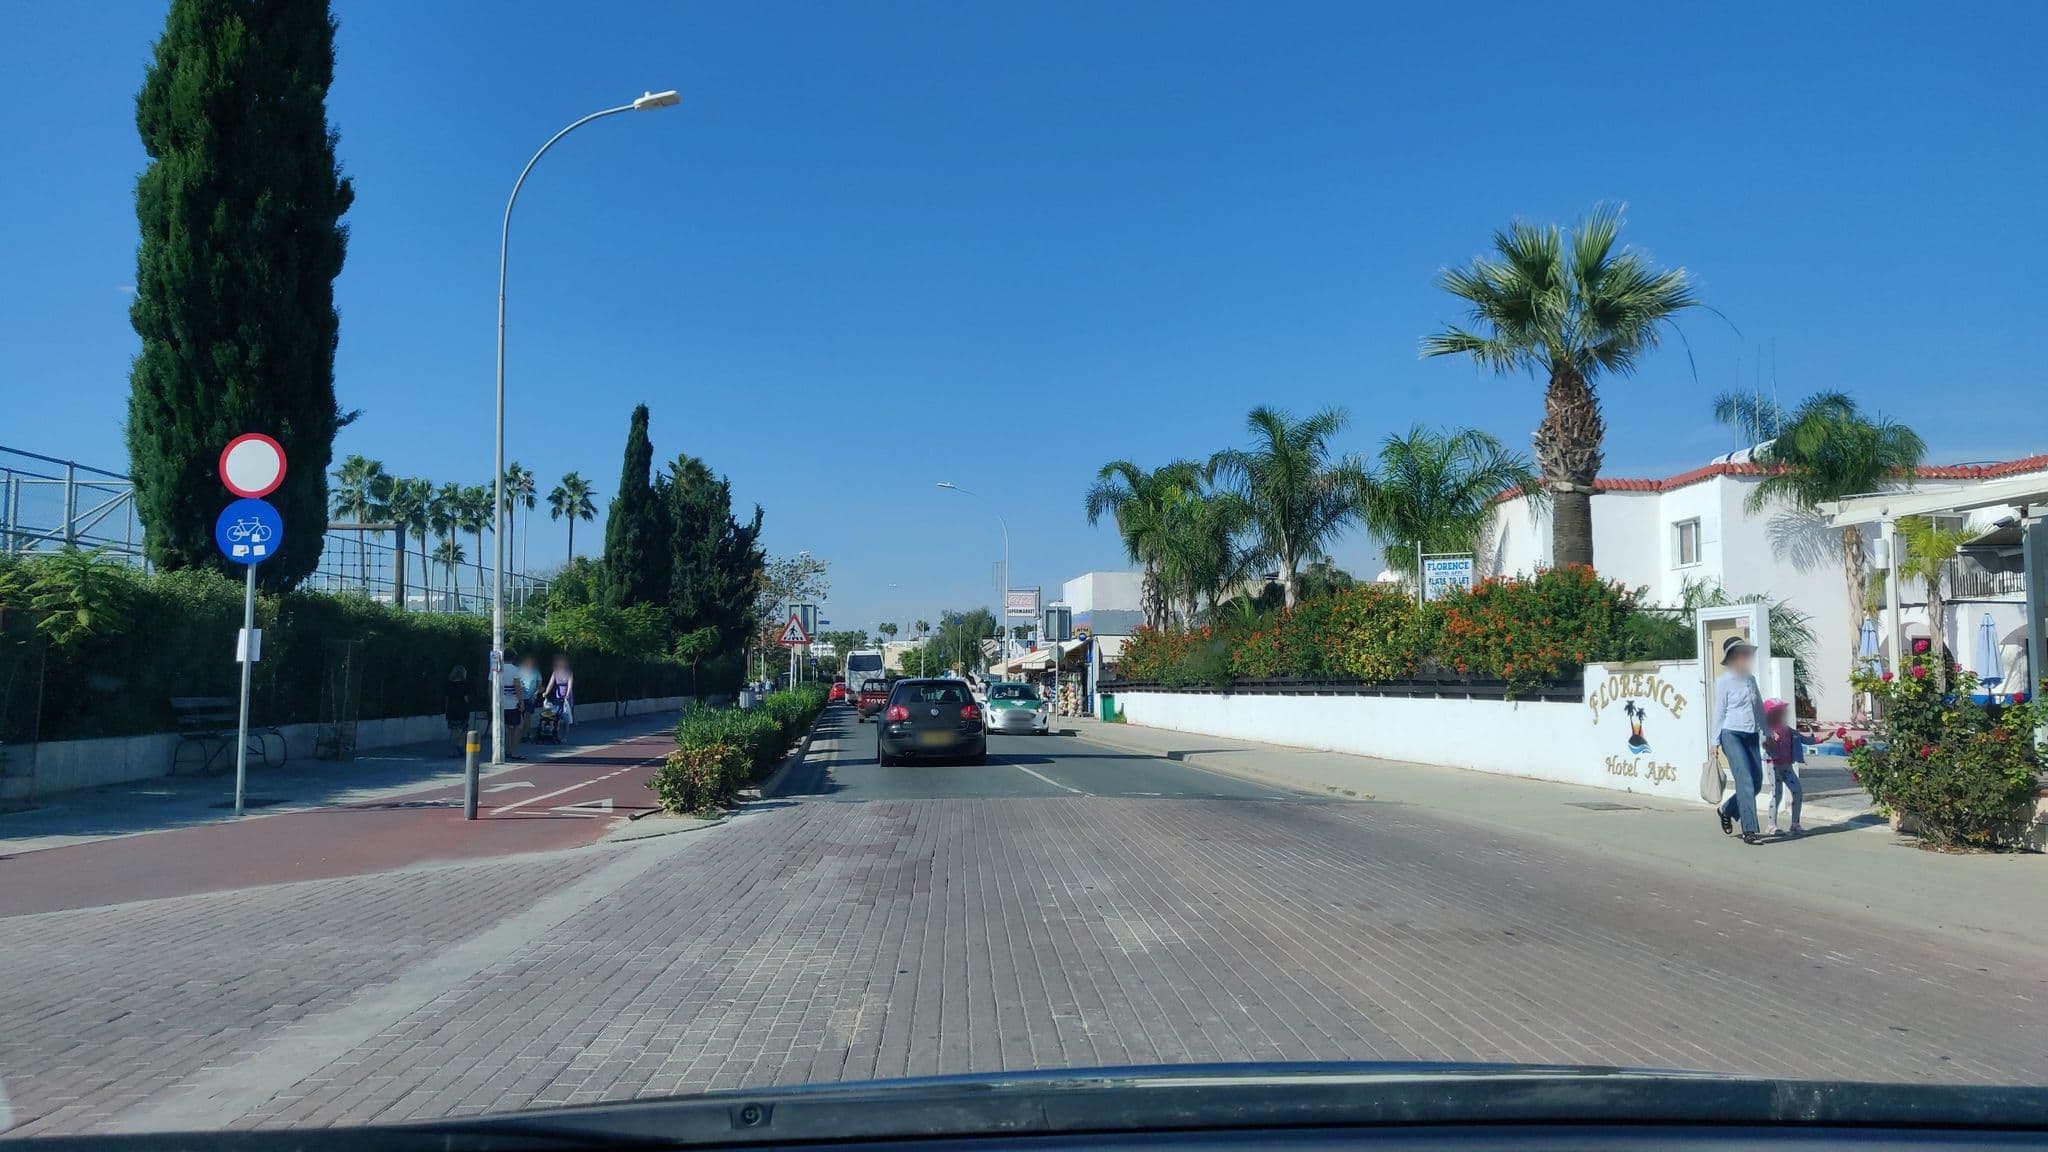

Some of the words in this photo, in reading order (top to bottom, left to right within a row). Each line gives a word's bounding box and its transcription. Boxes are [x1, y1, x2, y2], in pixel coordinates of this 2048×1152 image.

[1427, 561, 1469, 571] FLORENCE
[1458, 576, 1469, 585] LET
[1589, 672, 1687, 725] FLORENCE
[1605, 755, 1641, 777] Hotel
[1645, 761, 1677, 786] Apts
